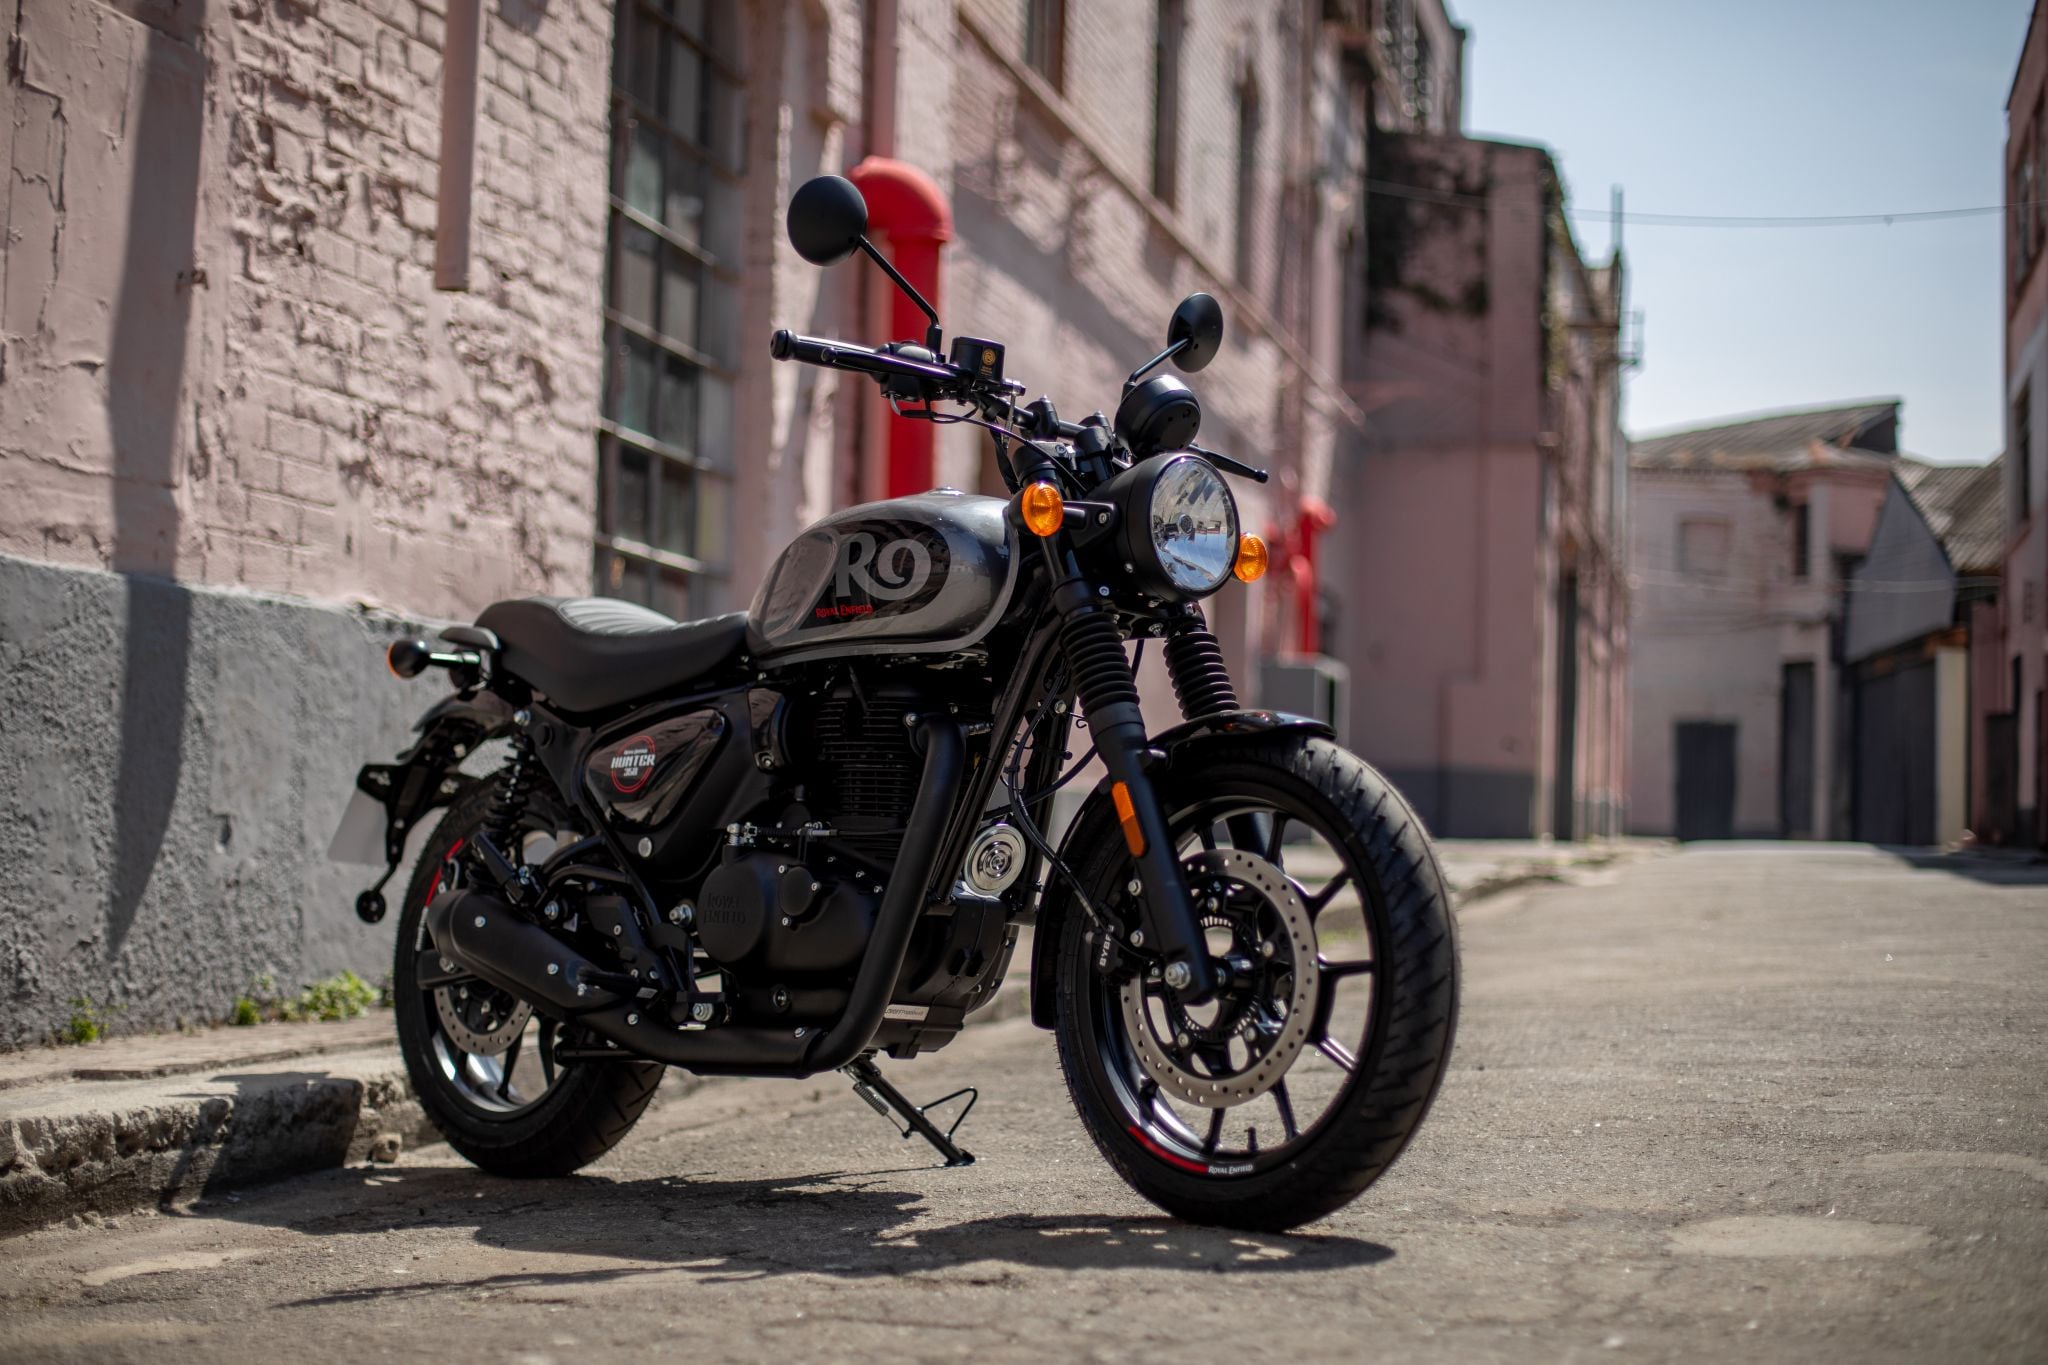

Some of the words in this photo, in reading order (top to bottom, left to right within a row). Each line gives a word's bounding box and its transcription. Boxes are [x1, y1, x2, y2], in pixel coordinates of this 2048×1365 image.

[815, 607, 839, 618] ROYAL
[840, 604, 874, 616] ENFIELD
[611, 754, 655, 769] HUNTER
[1209, 1166, 1228, 1174] ROYAL
[1229, 1164, 1253, 1174] ENFIELD
